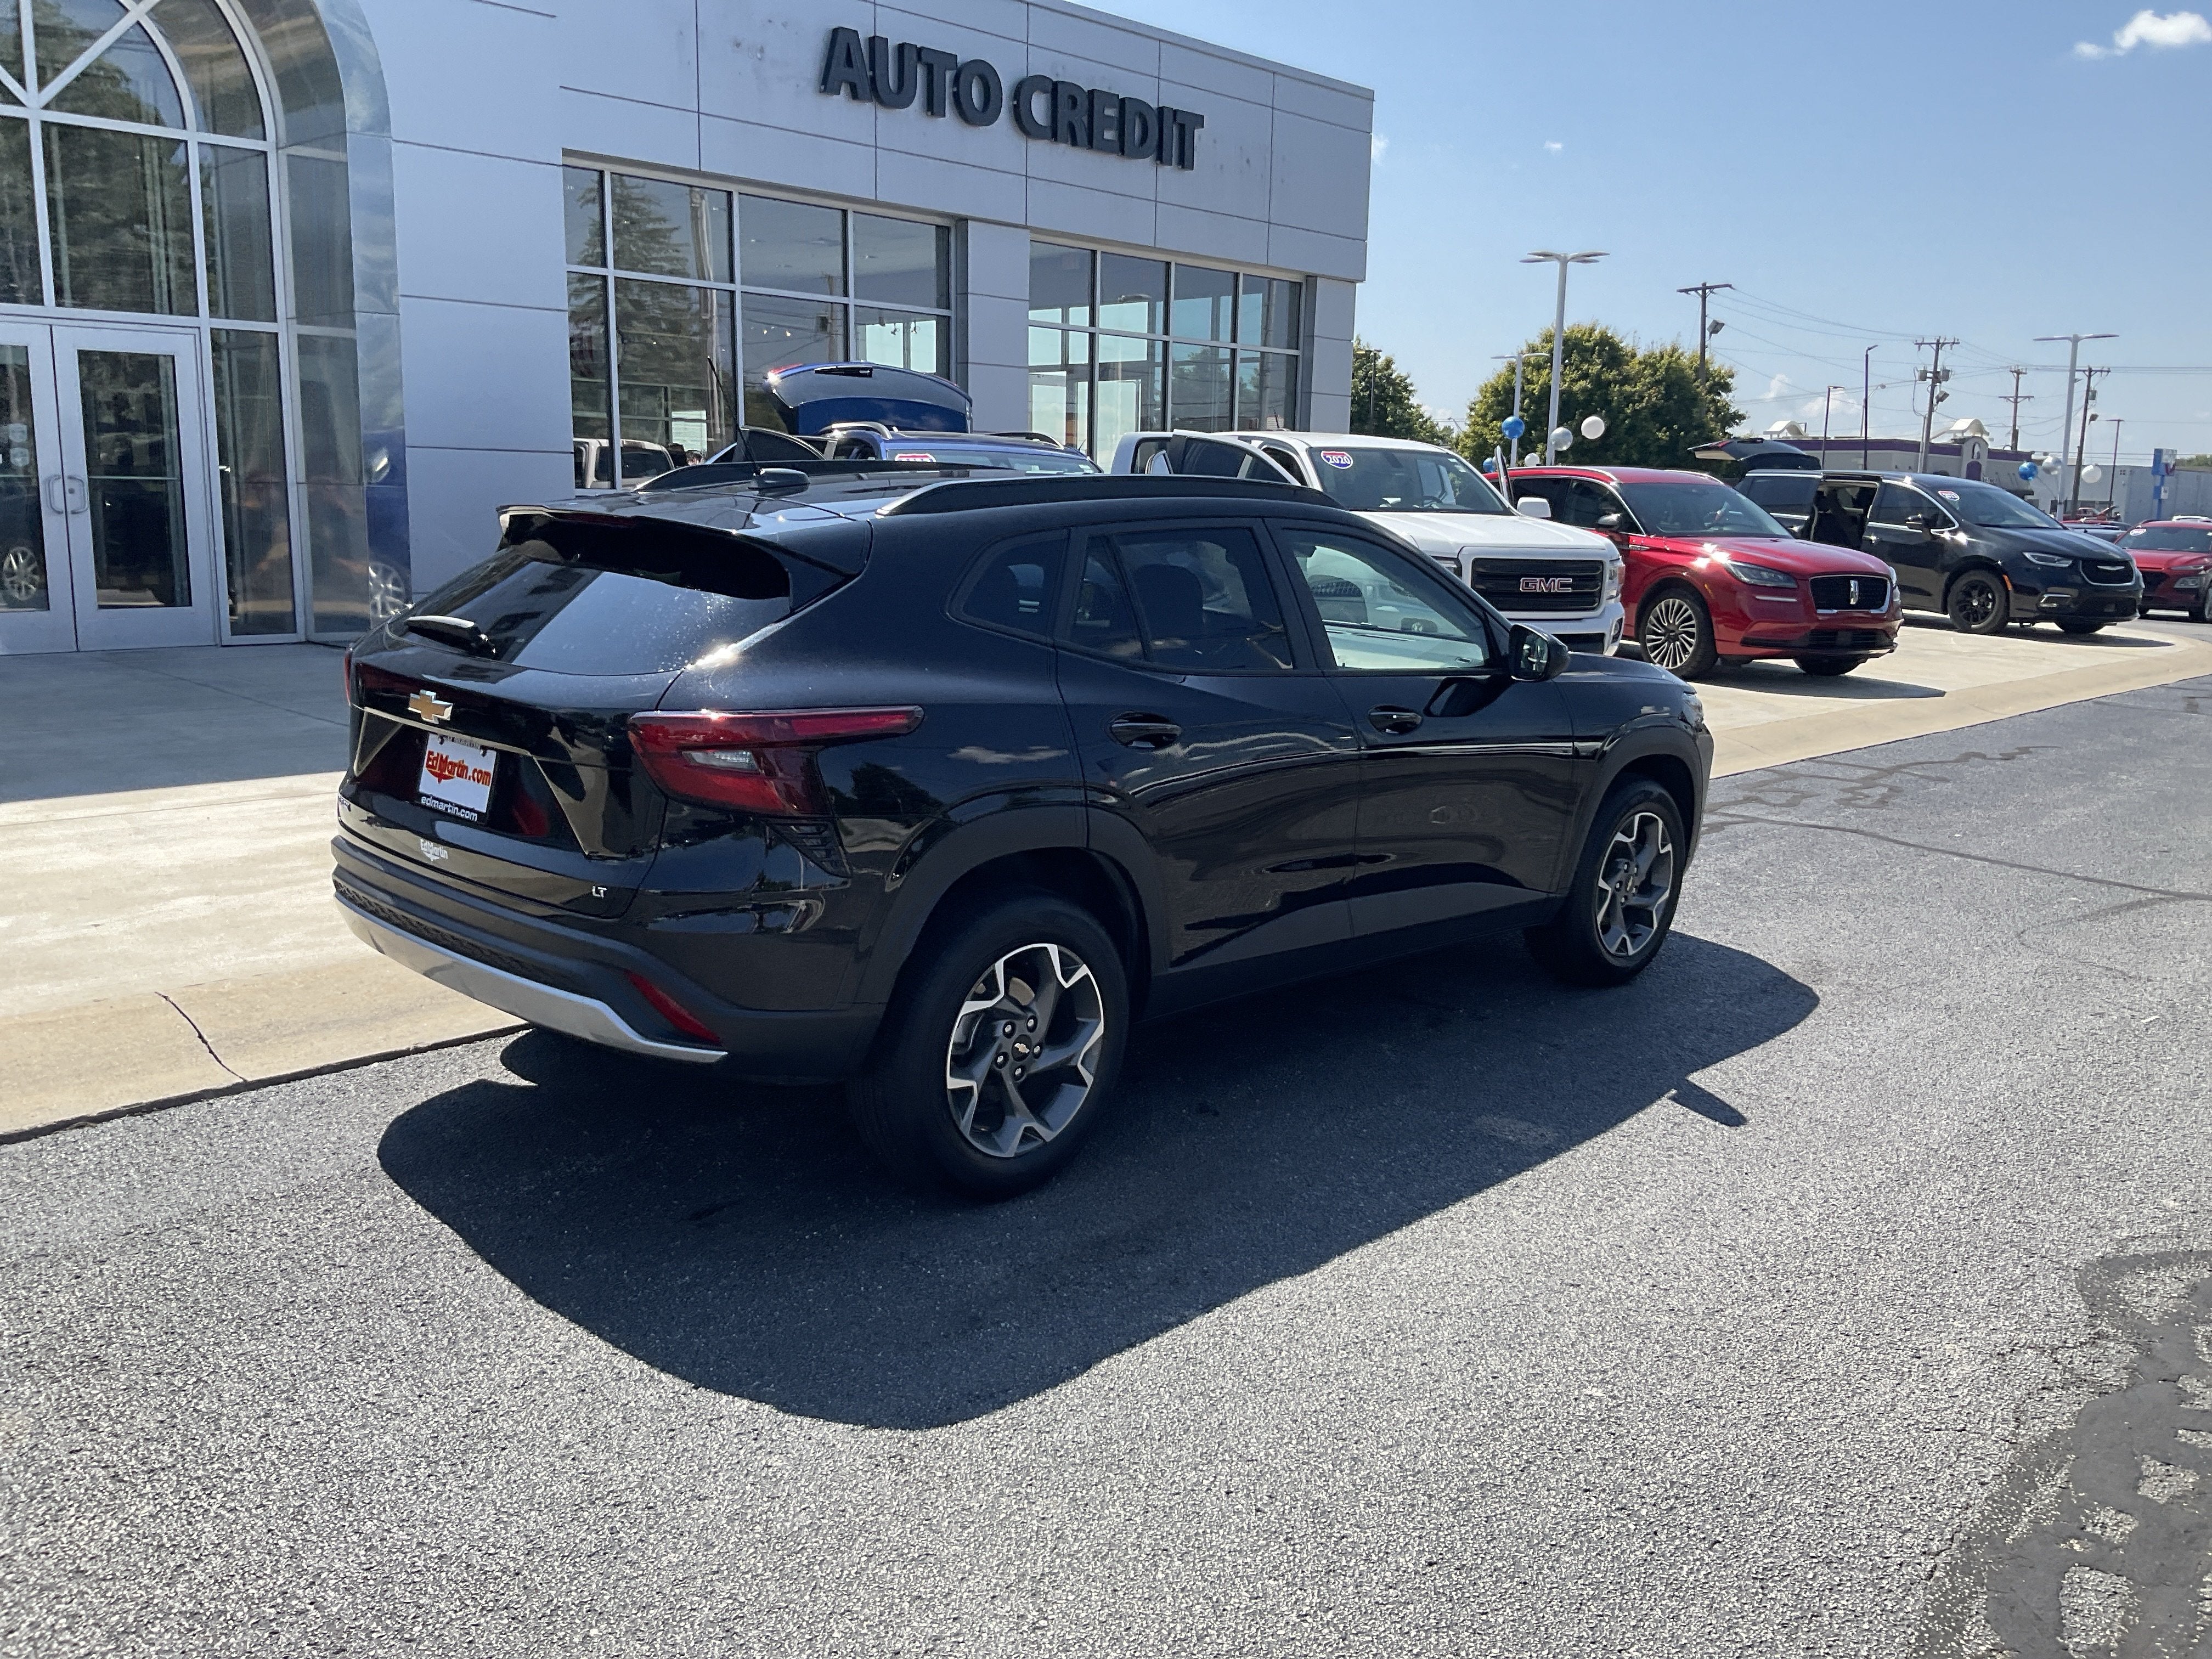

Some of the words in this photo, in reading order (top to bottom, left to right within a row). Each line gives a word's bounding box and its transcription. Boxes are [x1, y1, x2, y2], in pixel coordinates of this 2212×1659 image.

[819, 26, 1003, 127] AUTO
[1013, 74, 1205, 171] CREDIT
[1325, 455, 1351, 465] 2020
[1520, 577, 1572, 592] GMC
[421, 795, 478, 821] edmartin.com
[592, 885, 607, 899] LT
